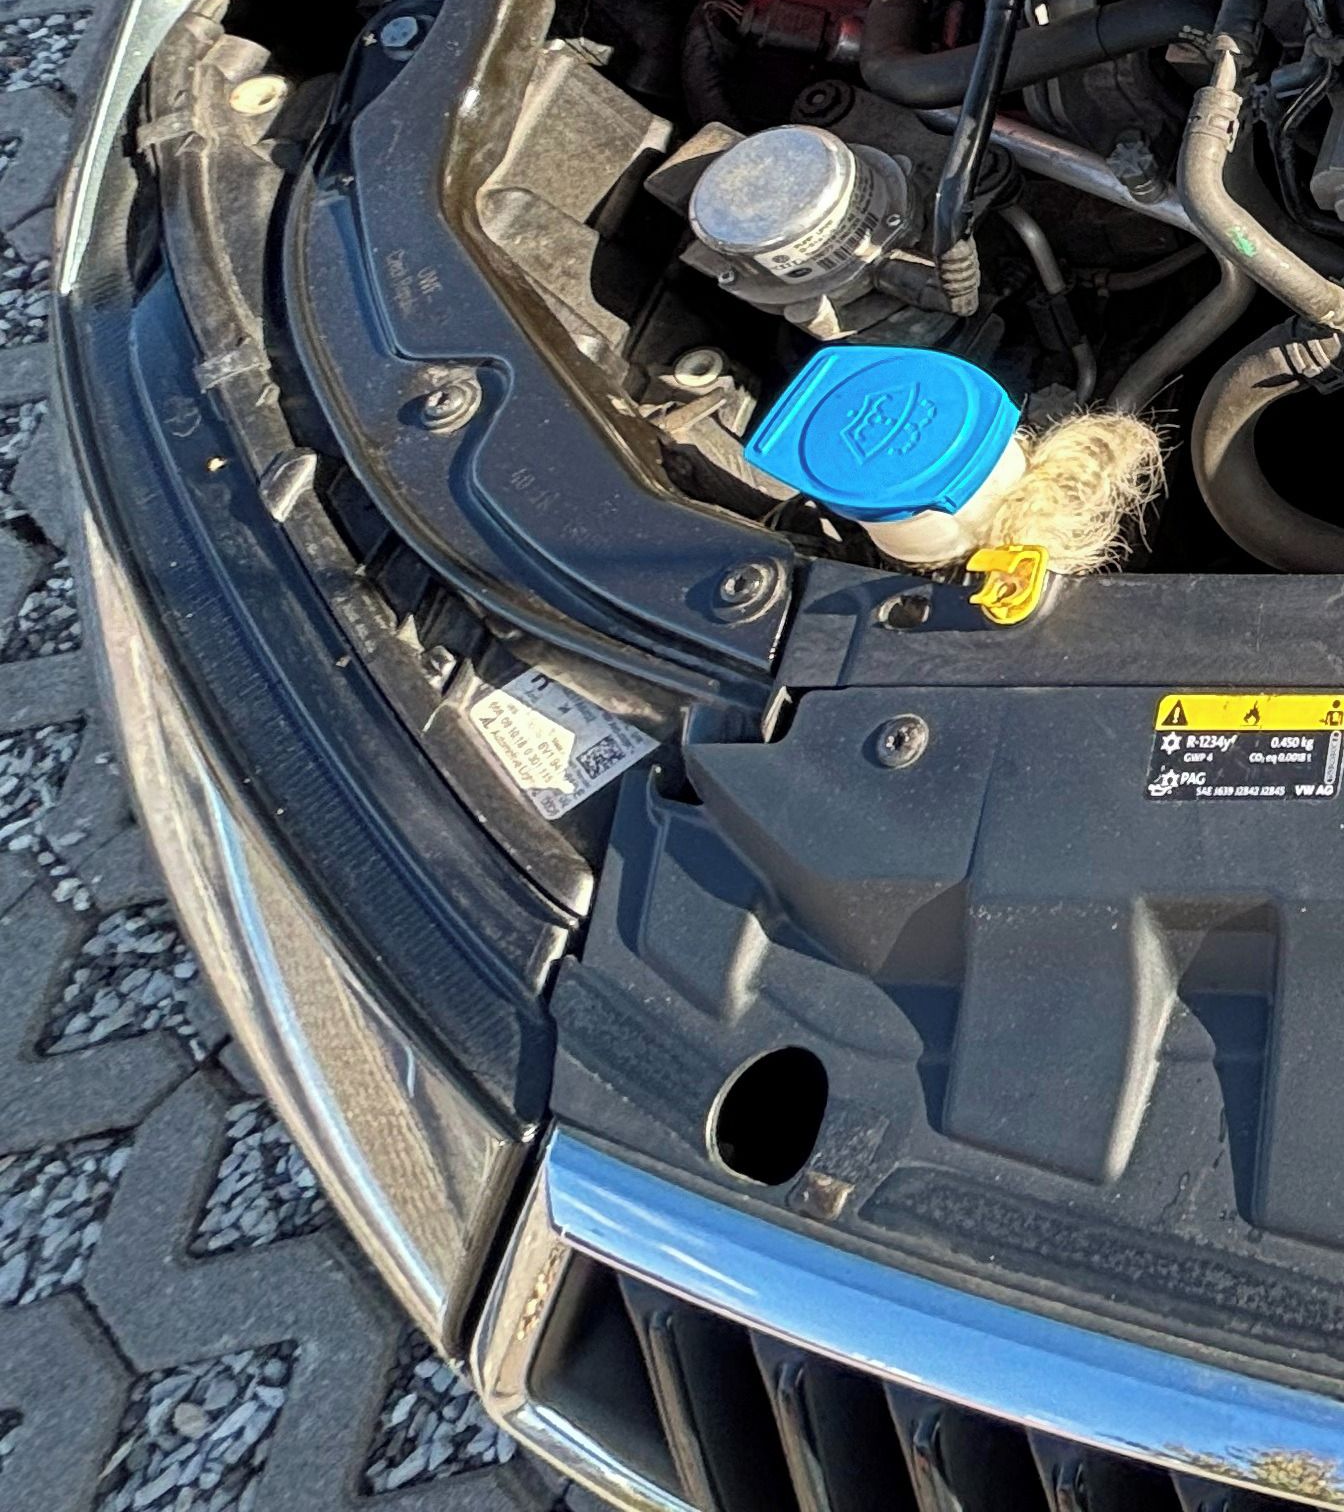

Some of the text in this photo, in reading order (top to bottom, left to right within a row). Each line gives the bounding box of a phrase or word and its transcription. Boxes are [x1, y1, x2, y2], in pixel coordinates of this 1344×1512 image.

[1301, 736, 1314, 751] kg
[1180, 772, 1207, 786] PAG
[1294, 785, 1334, 796] VW AG
